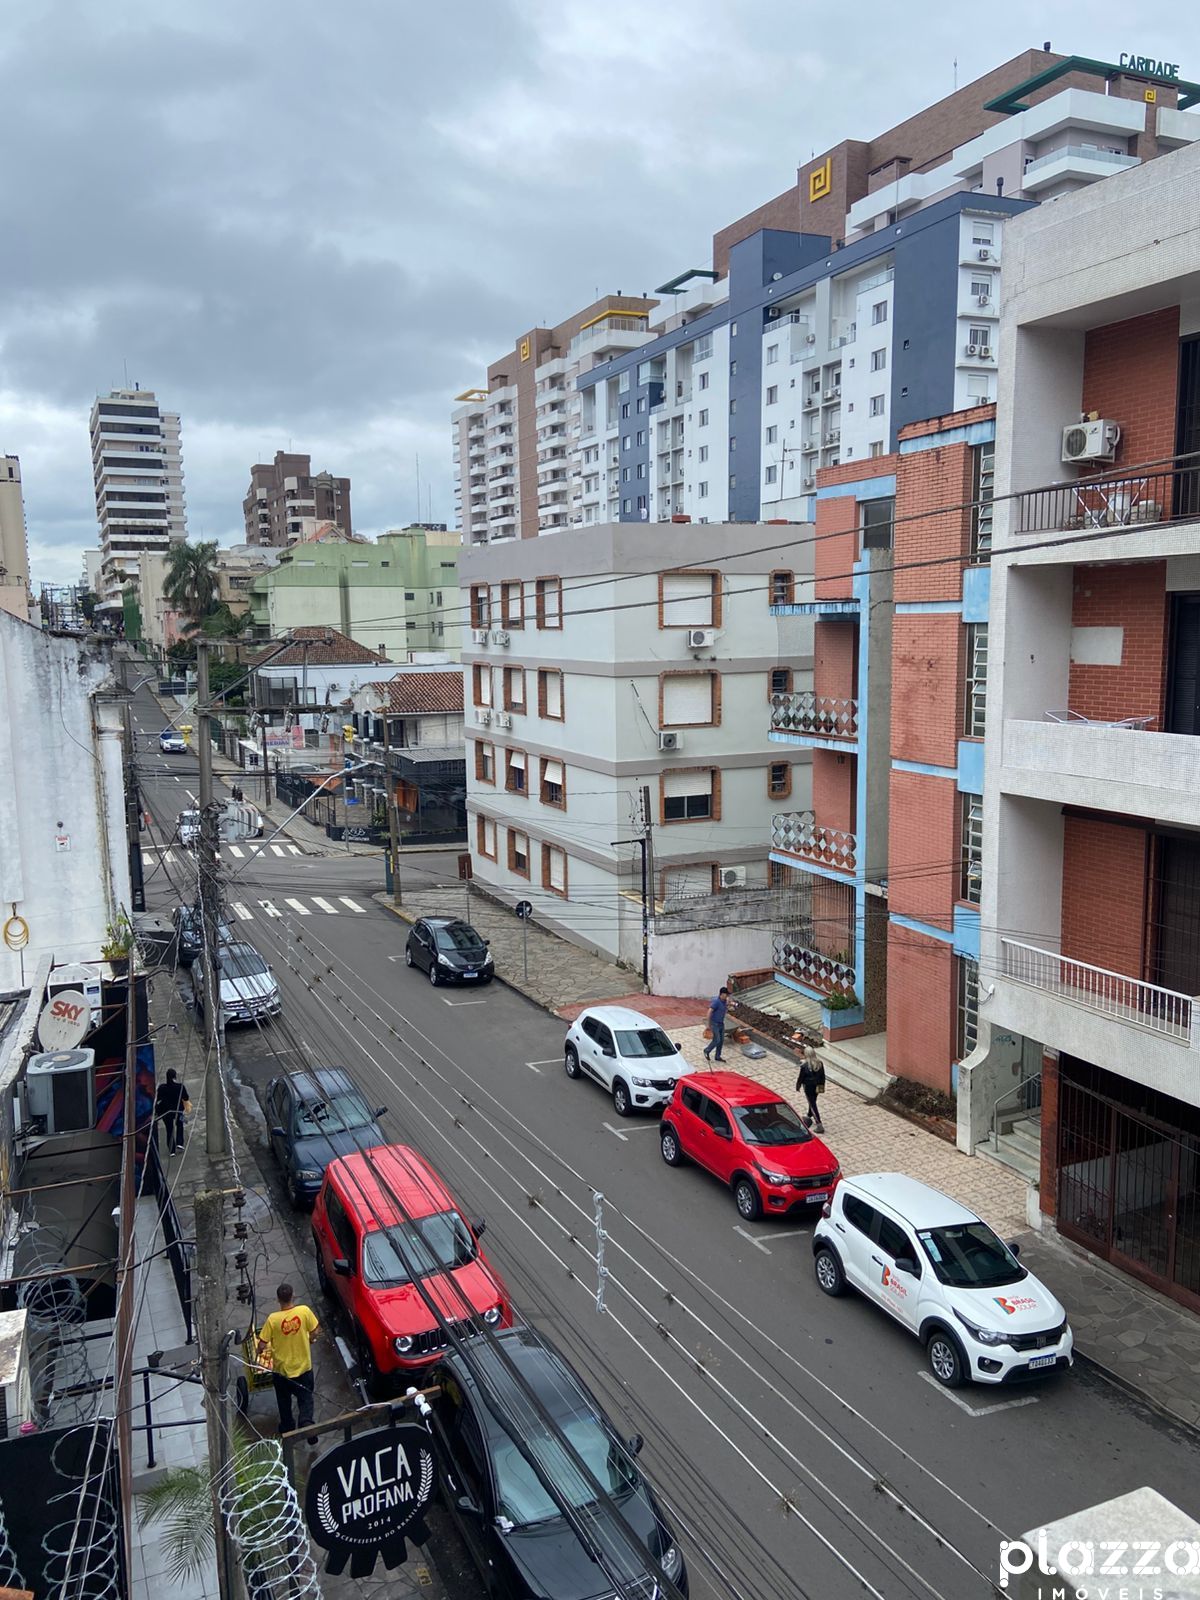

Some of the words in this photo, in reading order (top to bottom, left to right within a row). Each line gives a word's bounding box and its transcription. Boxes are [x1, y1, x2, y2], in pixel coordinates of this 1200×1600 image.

[1120, 52, 1180, 79] CARIDADE
[50, 1001, 84, 1021] SKY
[890, 1278, 908, 1296] BRASIL
[1011, 1297, 1037, 1305] BRASIL
[336, 1443, 413, 1498] VACA
[341, 1481, 414, 1524] PROFANA
[367, 1516, 391, 1530] 2014
[384, 1529, 395, 1538] DO
[397, 1508, 418, 1530] BRASIL
